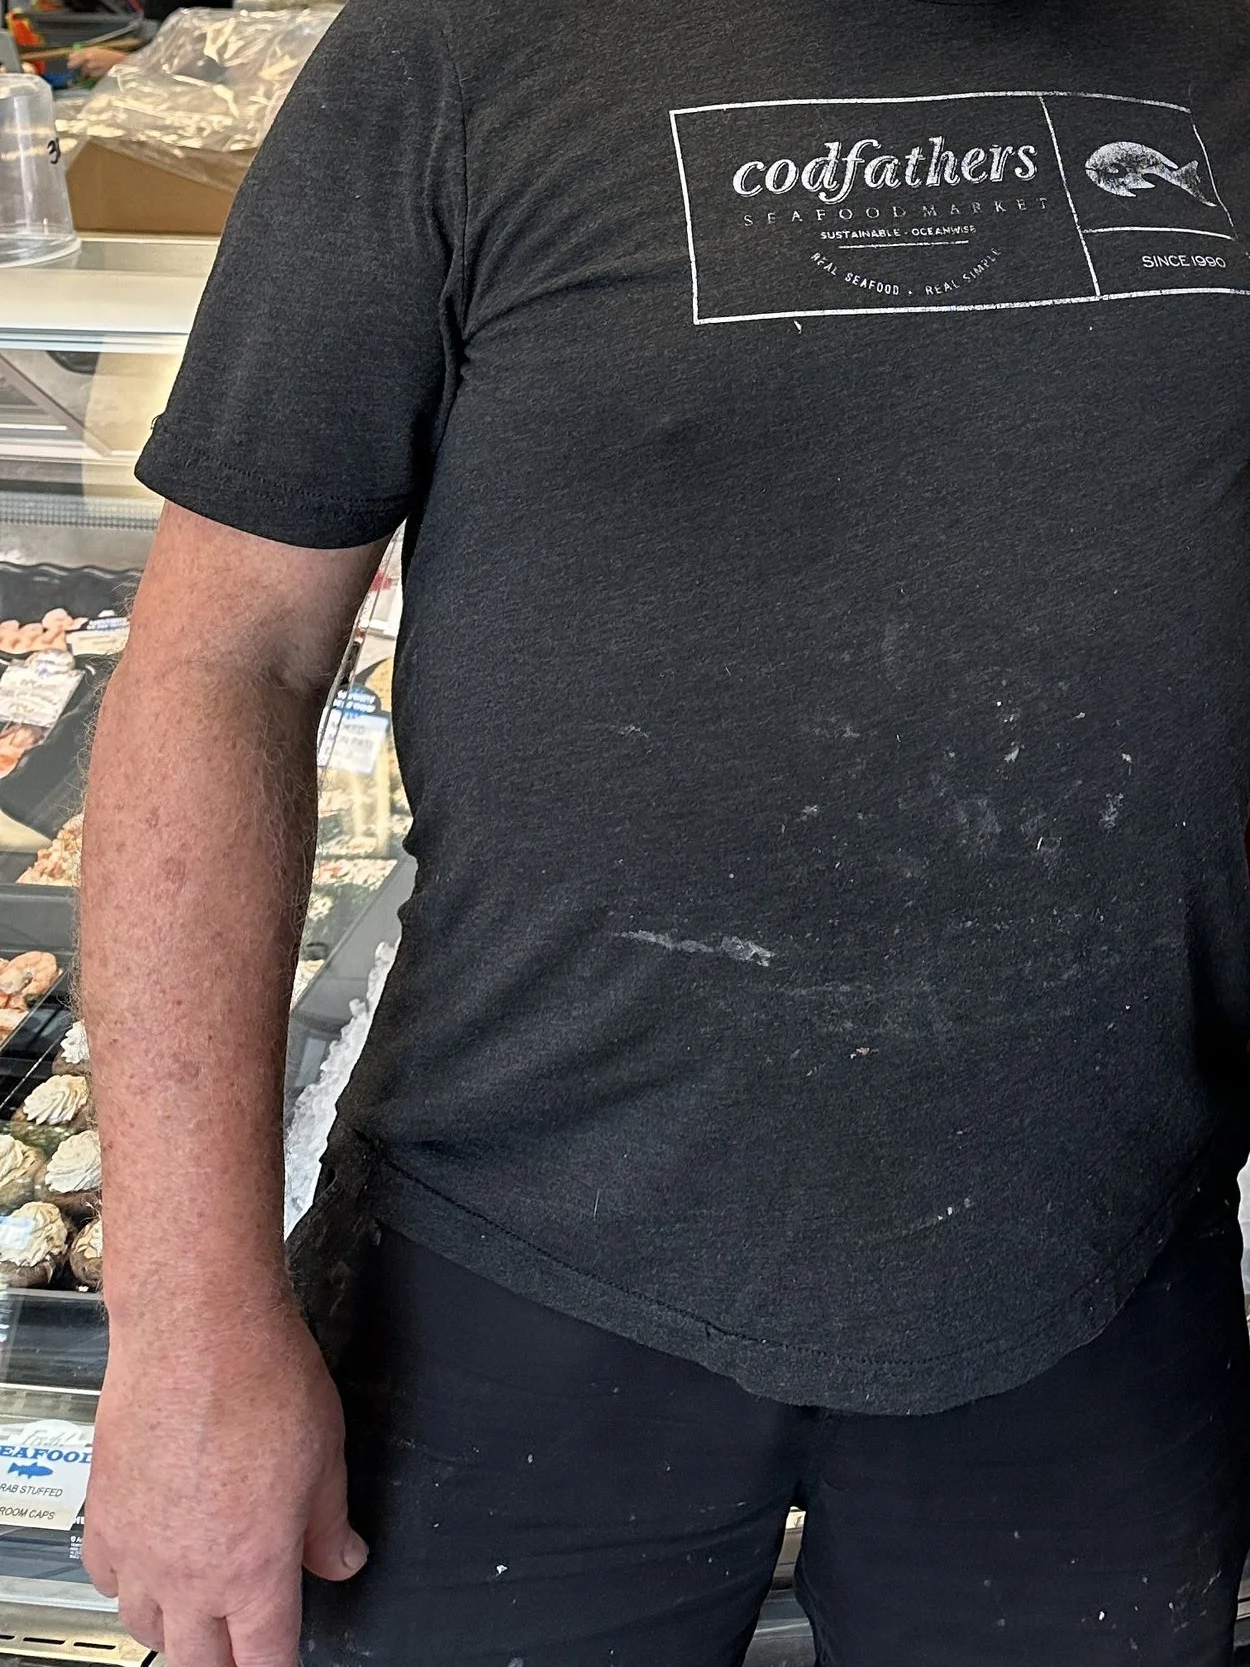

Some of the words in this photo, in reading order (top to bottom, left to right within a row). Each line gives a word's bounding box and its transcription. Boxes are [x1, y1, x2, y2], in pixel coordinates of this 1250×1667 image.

[732, 136, 1038, 205] codfathers
[743, 206, 906, 227] SEAFOOD
[922, 197, 1048, 218] MARKET
[820, 228, 901, 240] SUSTAINABLE
[911, 225, 977, 237] OCEANWISE
[1142, 255, 1190, 268] SINCE
[1191, 255, 1226, 268] 1990
[810, 252, 837, 276] REAL
[844, 272, 900, 296] SEAFOOD
[925, 279, 961, 296] REAL
[20, 1485, 63, 1498] STUFFED
[28, 1509, 56, 1520] CAPS
